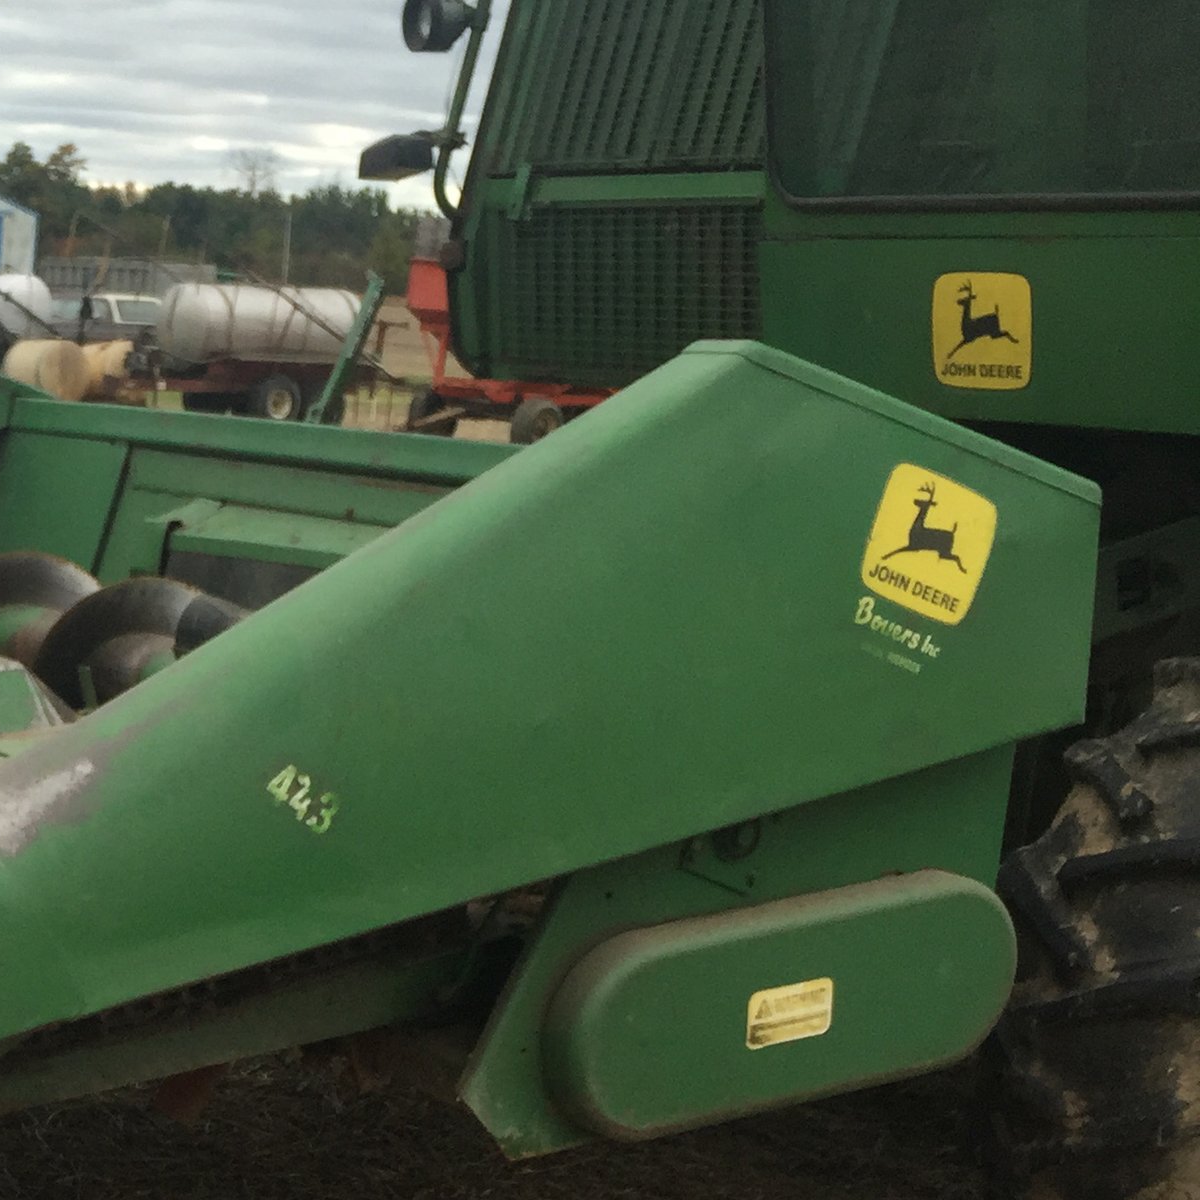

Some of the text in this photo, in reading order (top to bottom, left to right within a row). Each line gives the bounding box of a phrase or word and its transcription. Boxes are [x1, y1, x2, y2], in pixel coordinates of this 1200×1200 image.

[941, 362, 1023, 380] JOHN DEERE
[869, 564, 960, 613] JOHN DEERE
